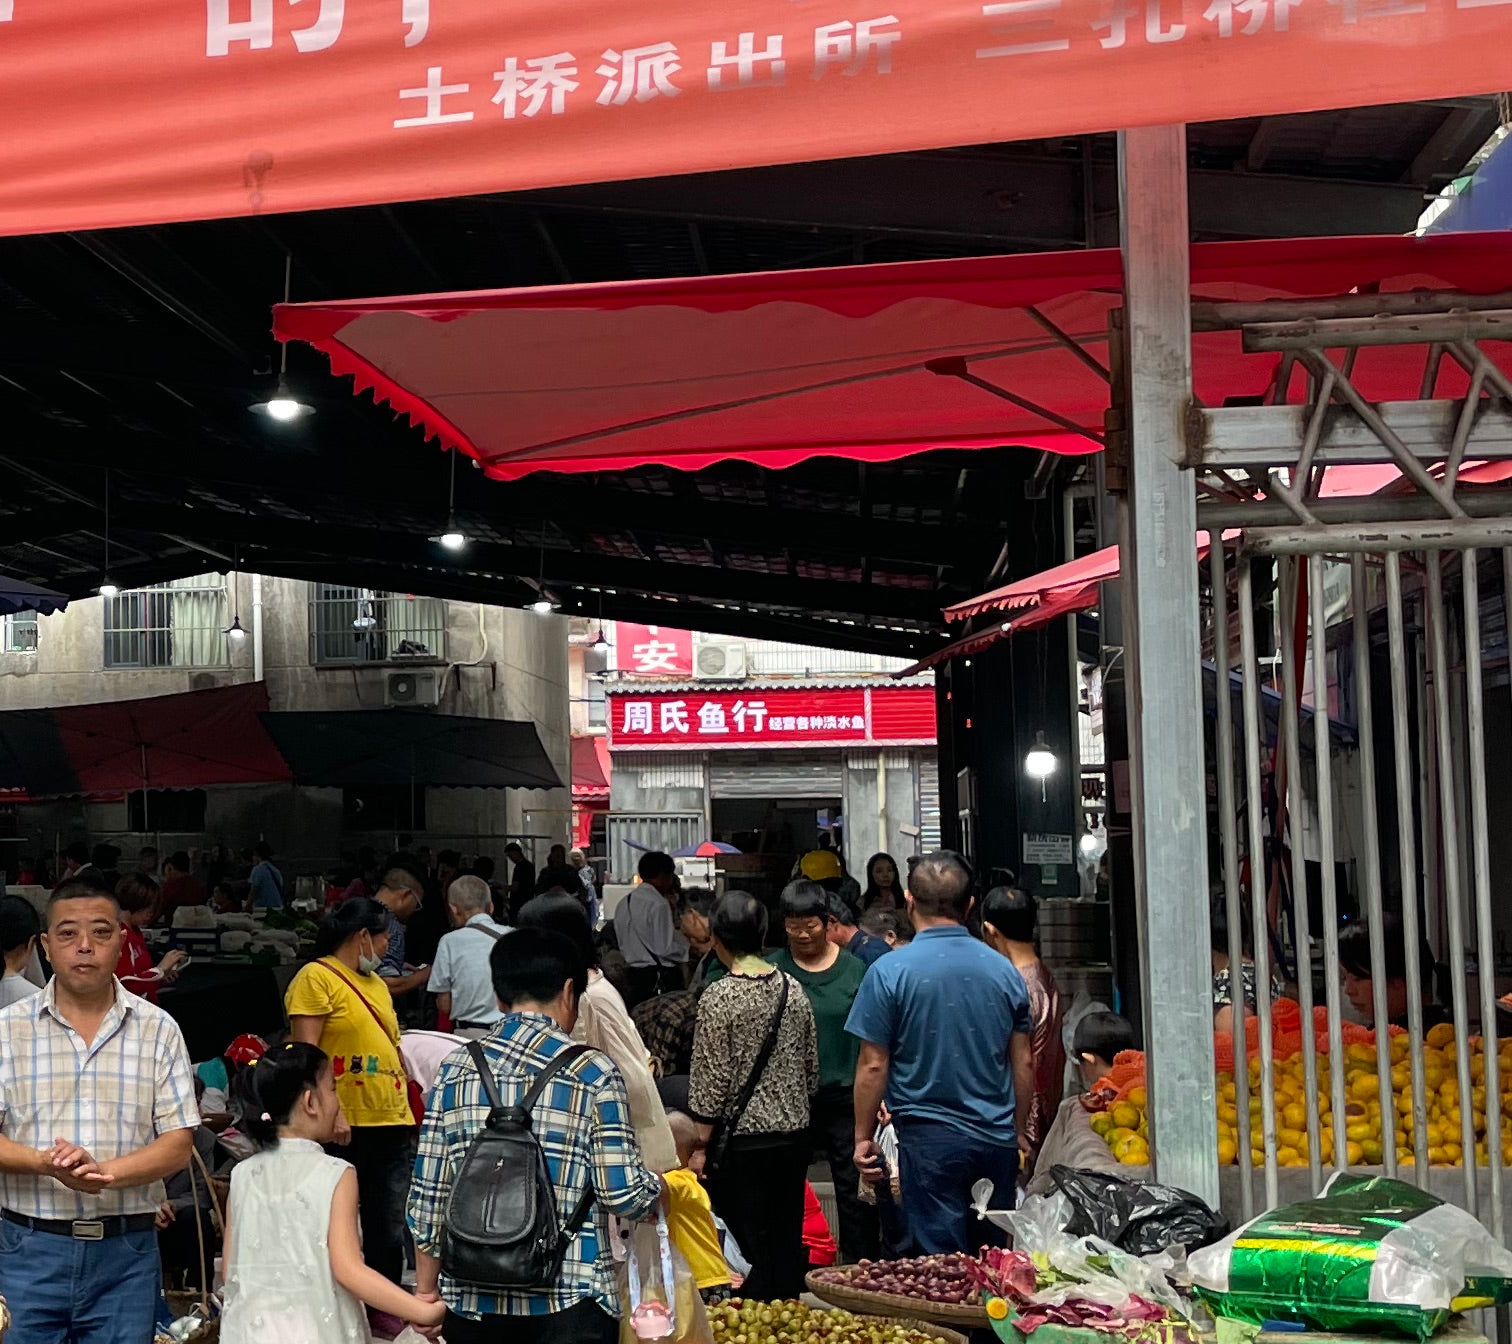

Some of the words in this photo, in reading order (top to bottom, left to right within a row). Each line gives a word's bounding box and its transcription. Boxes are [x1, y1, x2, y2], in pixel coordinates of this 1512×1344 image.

[393, 13, 903, 130] 土桥派出所
[622, 700, 768, 735] 周氏鱼行
[768, 715, 866, 731] 经营各种淡水鱼
